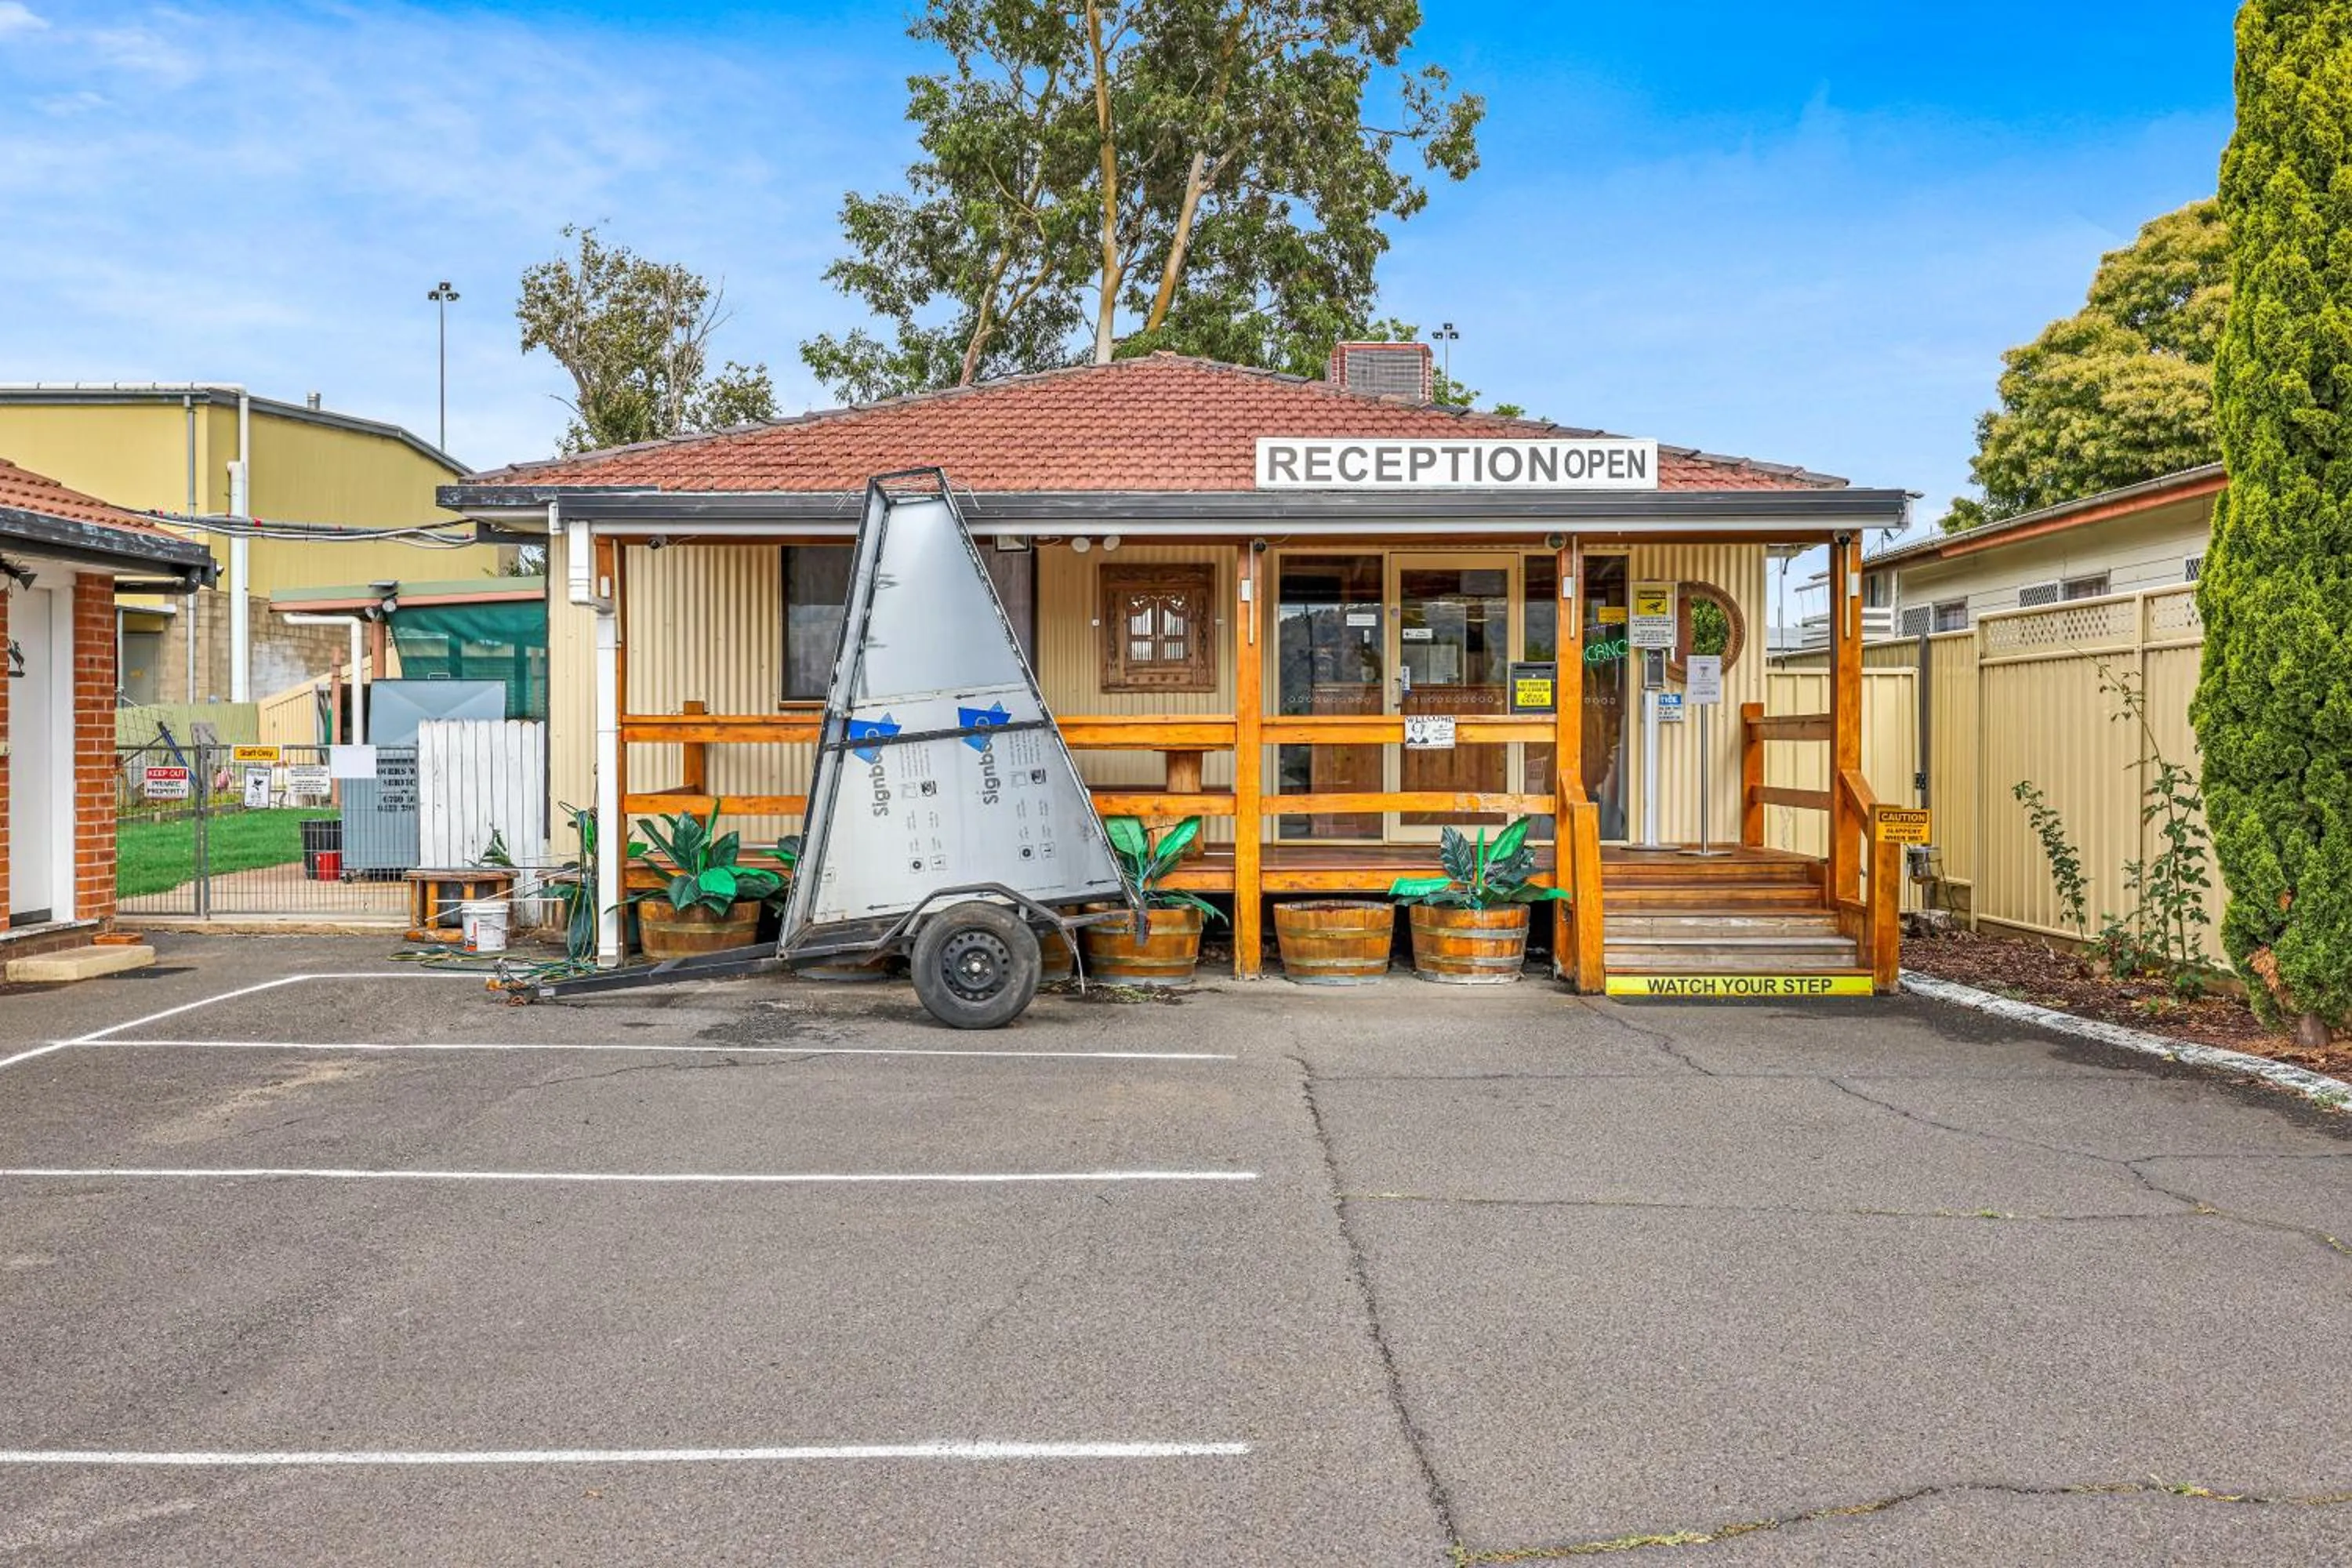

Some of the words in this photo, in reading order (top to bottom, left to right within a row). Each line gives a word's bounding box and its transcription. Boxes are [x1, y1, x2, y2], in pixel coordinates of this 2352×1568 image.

[1267, 445, 1558, 482] RECEPTION
[1564, 448, 1646, 479] OPEN
[1584, 639, 1629, 662] CANC
[1881, 813, 1925, 822] CAUTION
[1647, 978, 1715, 993] WATCH
[1721, 978, 1777, 993] YOUR
[1784, 978, 1832, 993] STEP
